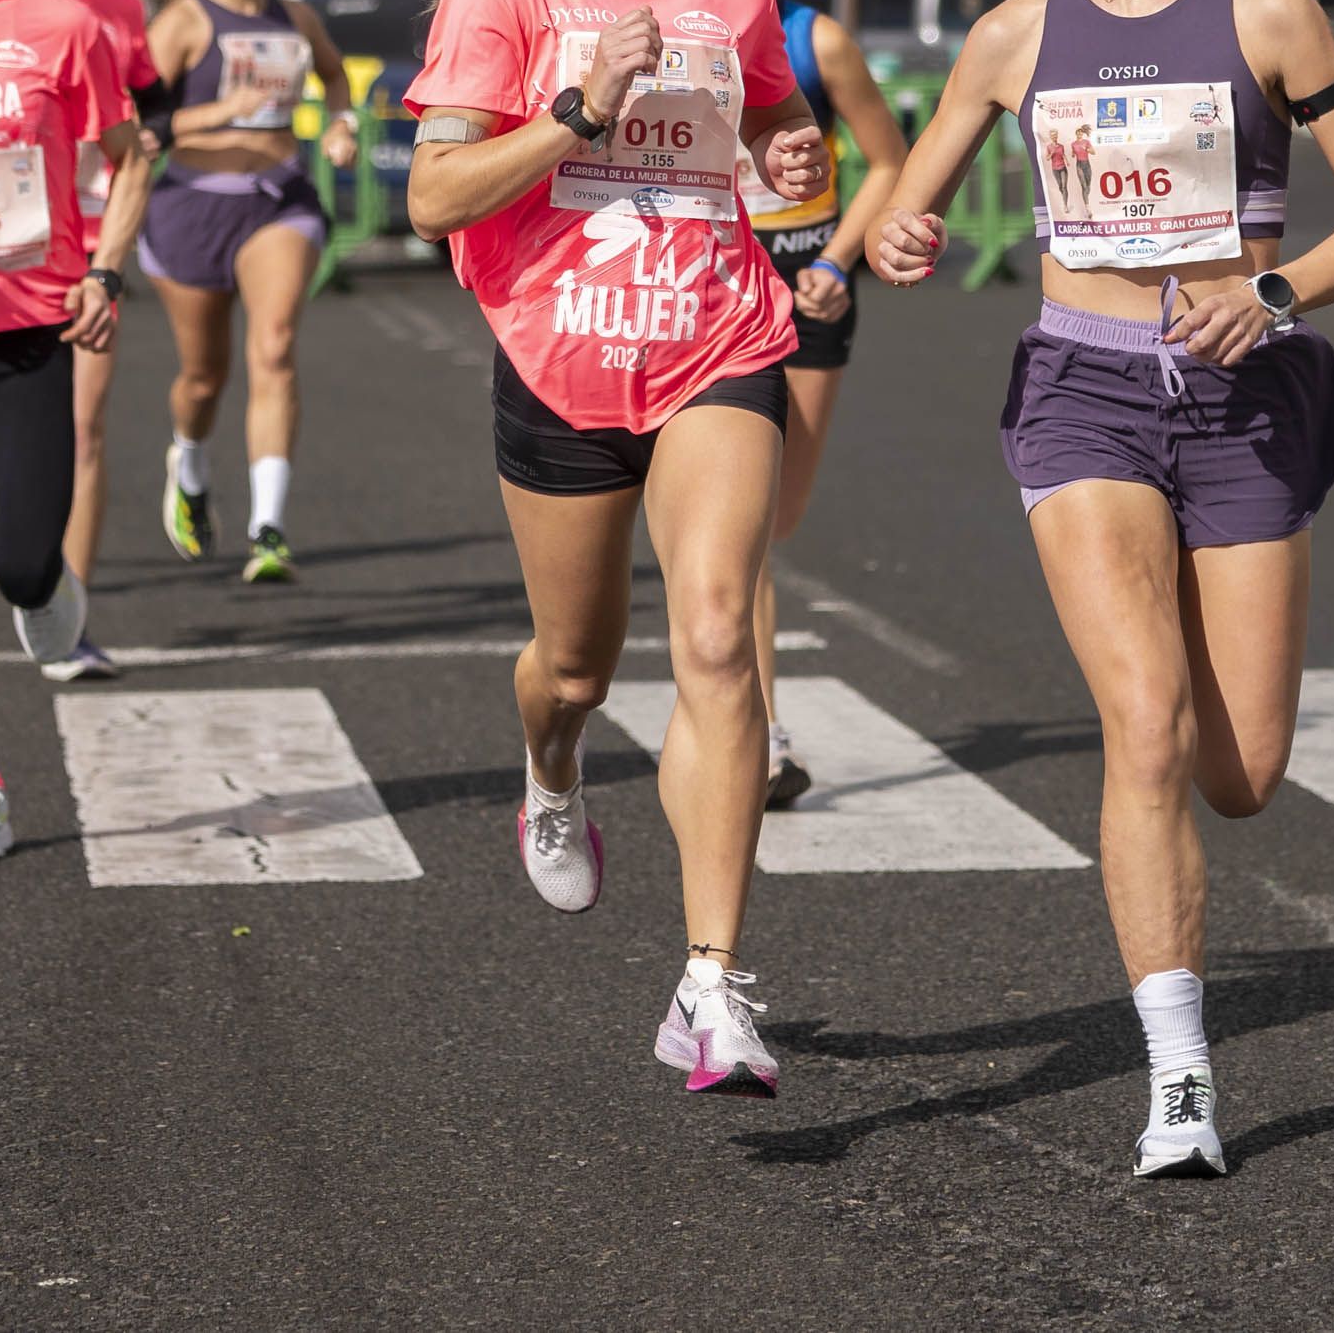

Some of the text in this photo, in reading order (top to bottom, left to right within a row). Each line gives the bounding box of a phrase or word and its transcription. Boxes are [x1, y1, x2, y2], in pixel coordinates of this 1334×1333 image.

[1099, 65, 1159, 80] OYSHO
[1049, 108, 1084, 120] SUMA
[625, 118, 693, 149] 016
[641, 153, 675, 168] 3155
[563, 165, 728, 187] CARRERA DE LA MUJER GRAN CANARIA
[1099, 168, 1173, 199] 016
[573, 189, 610, 202] OYSHO
[1122, 203, 1155, 218] 1907
[1058, 215, 1227, 235] CARRERA DE LA MUJER GRAN CANARIA
[632, 224, 677, 287] LA
[1068, 249, 1098, 259] OYSHO
[552, 282, 700, 342] MUJER
